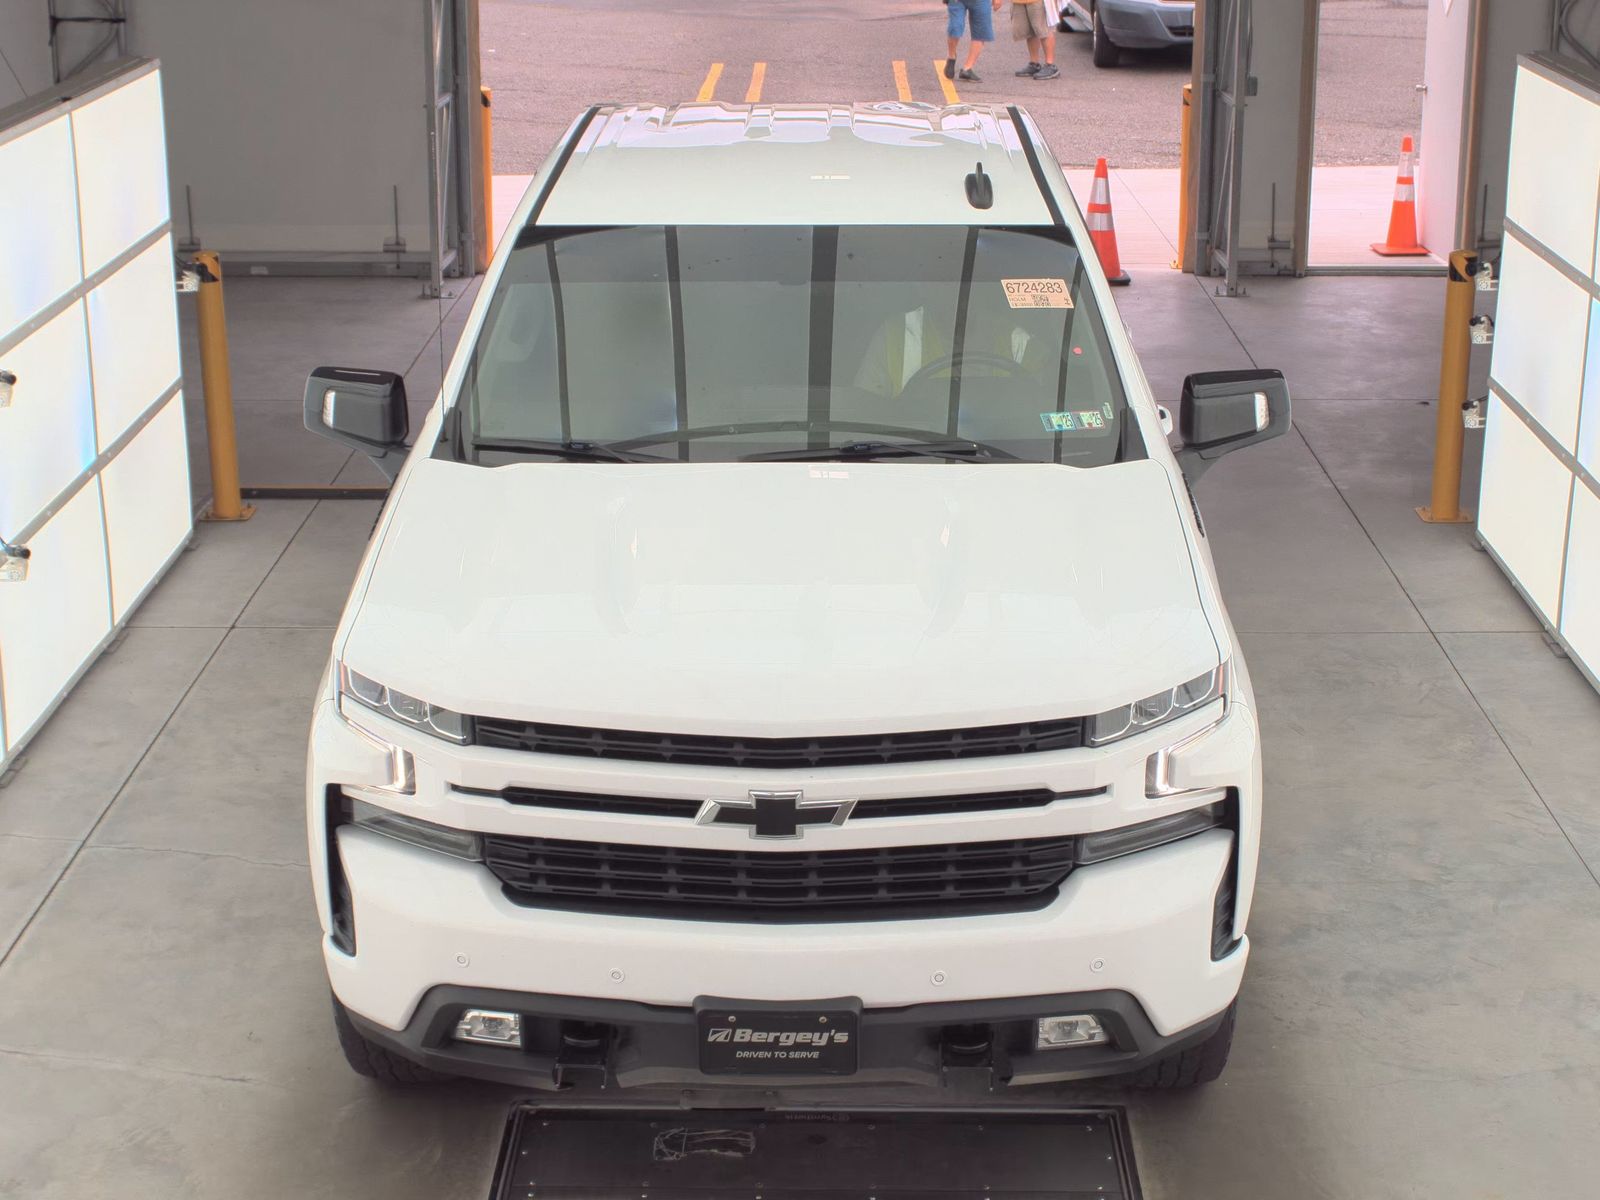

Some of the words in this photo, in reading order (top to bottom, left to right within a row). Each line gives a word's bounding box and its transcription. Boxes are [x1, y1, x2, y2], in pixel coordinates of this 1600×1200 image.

[1005, 282, 1063, 294] 6724283
[733, 1028, 849, 1046] Bergey's
[735, 1051, 772, 1059] DRIVEN
[774, 1051, 788, 1059] TO
[788, 1051, 820, 1059] SERVE
